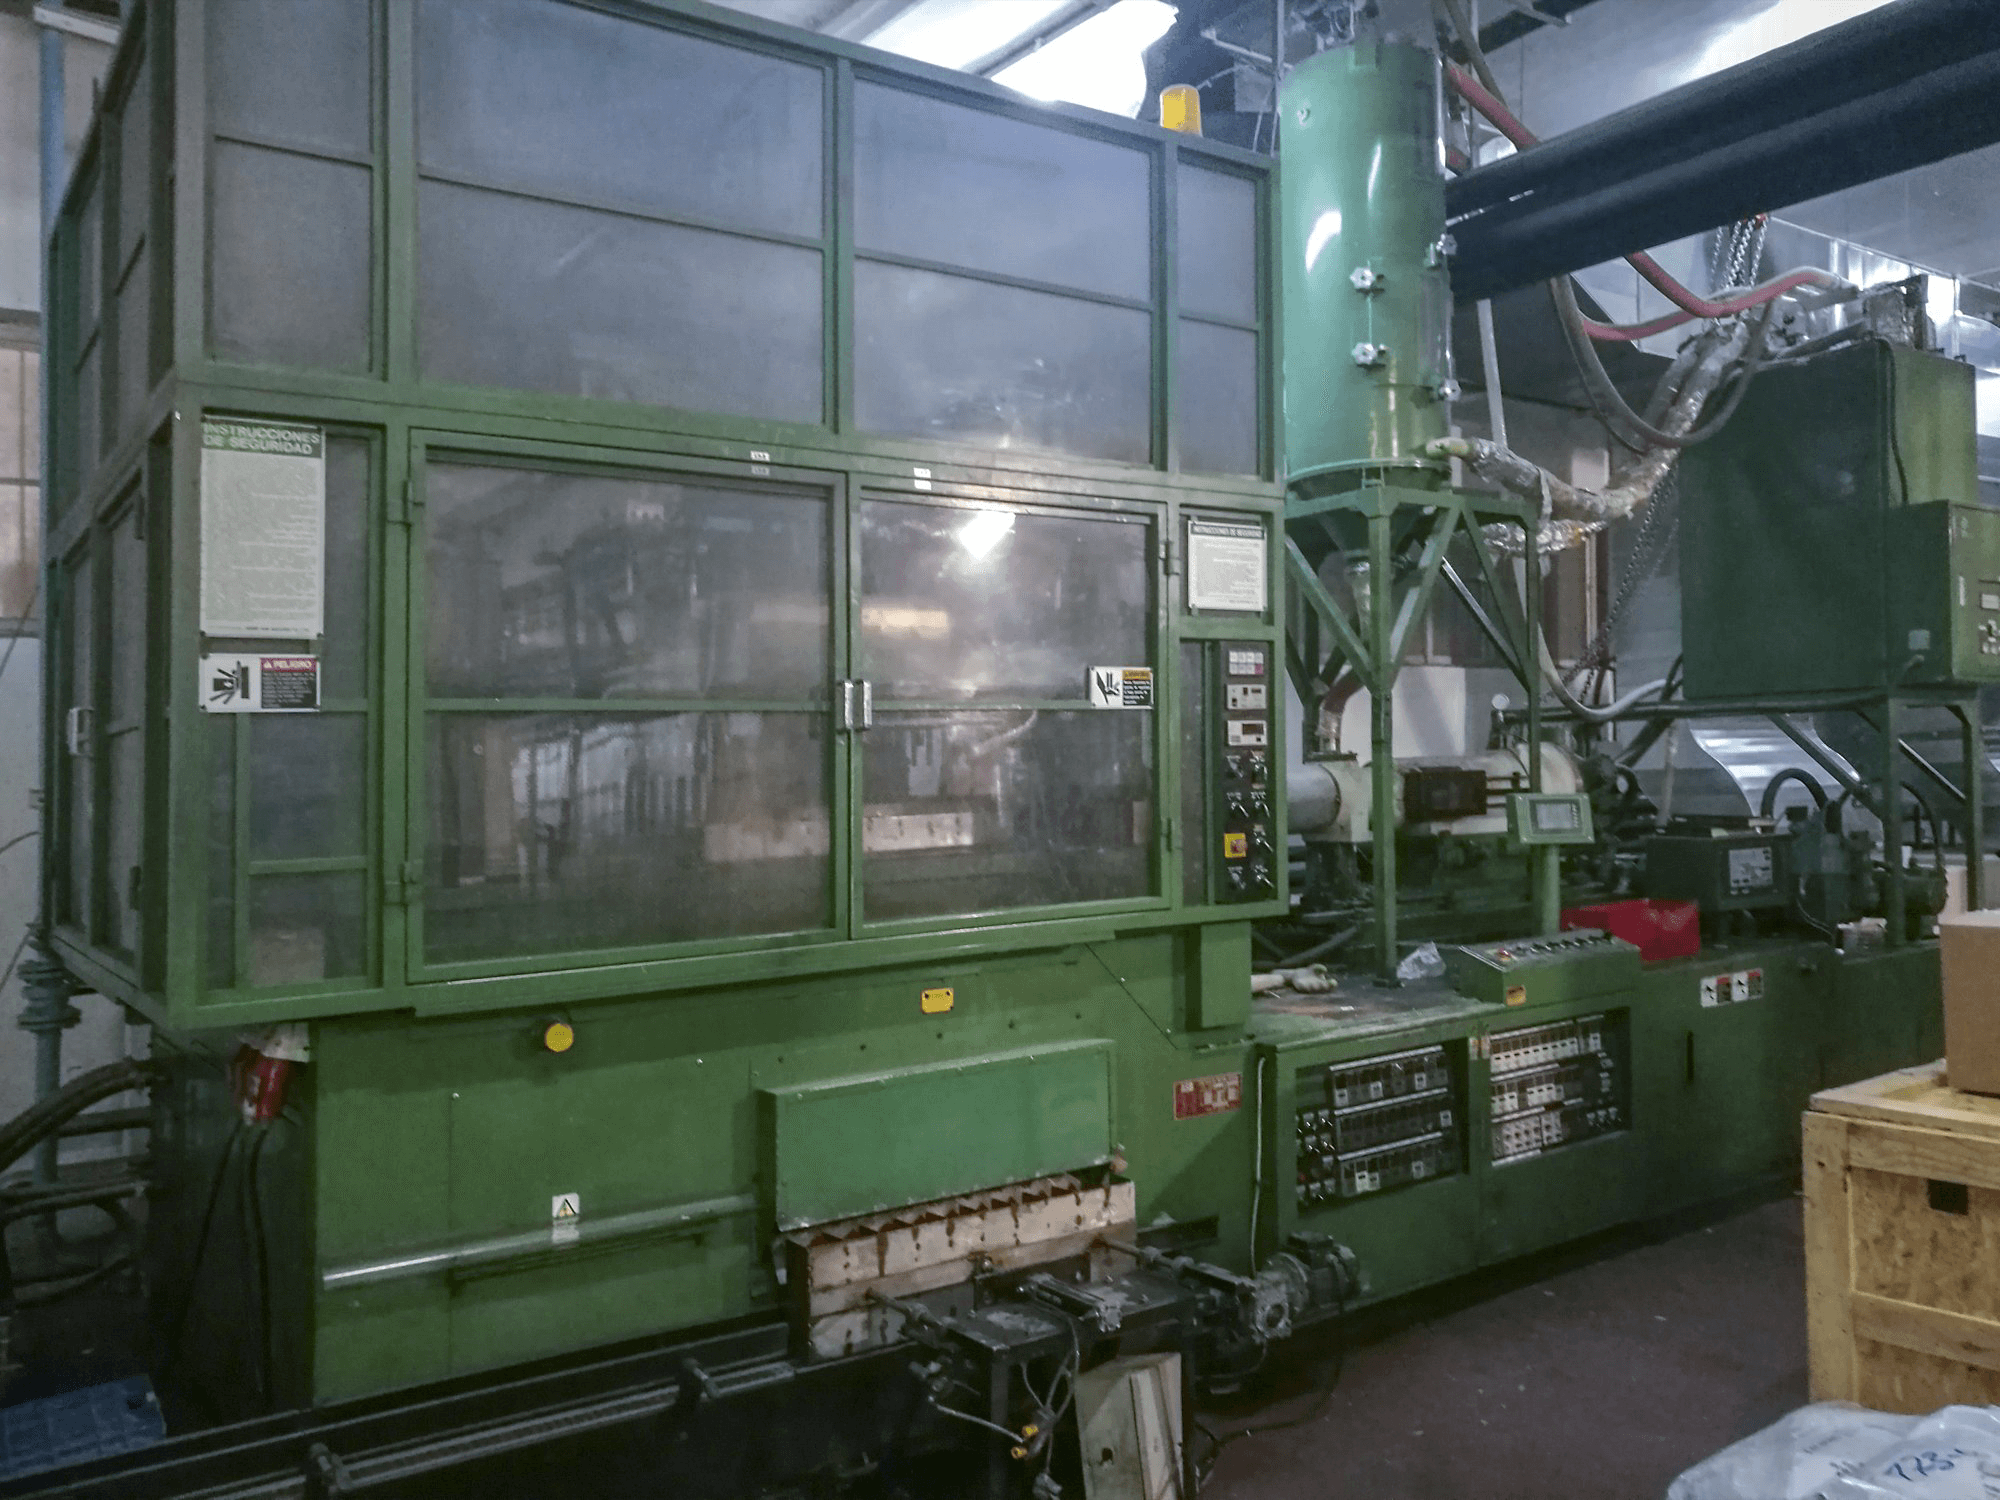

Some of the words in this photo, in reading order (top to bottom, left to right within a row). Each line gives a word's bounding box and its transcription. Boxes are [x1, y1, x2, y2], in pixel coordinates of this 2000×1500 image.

[202, 423, 320, 444] INSTRUCCIONES
[203, 434, 225, 447] DE
[229, 437, 312, 455] SEGURIDAD
